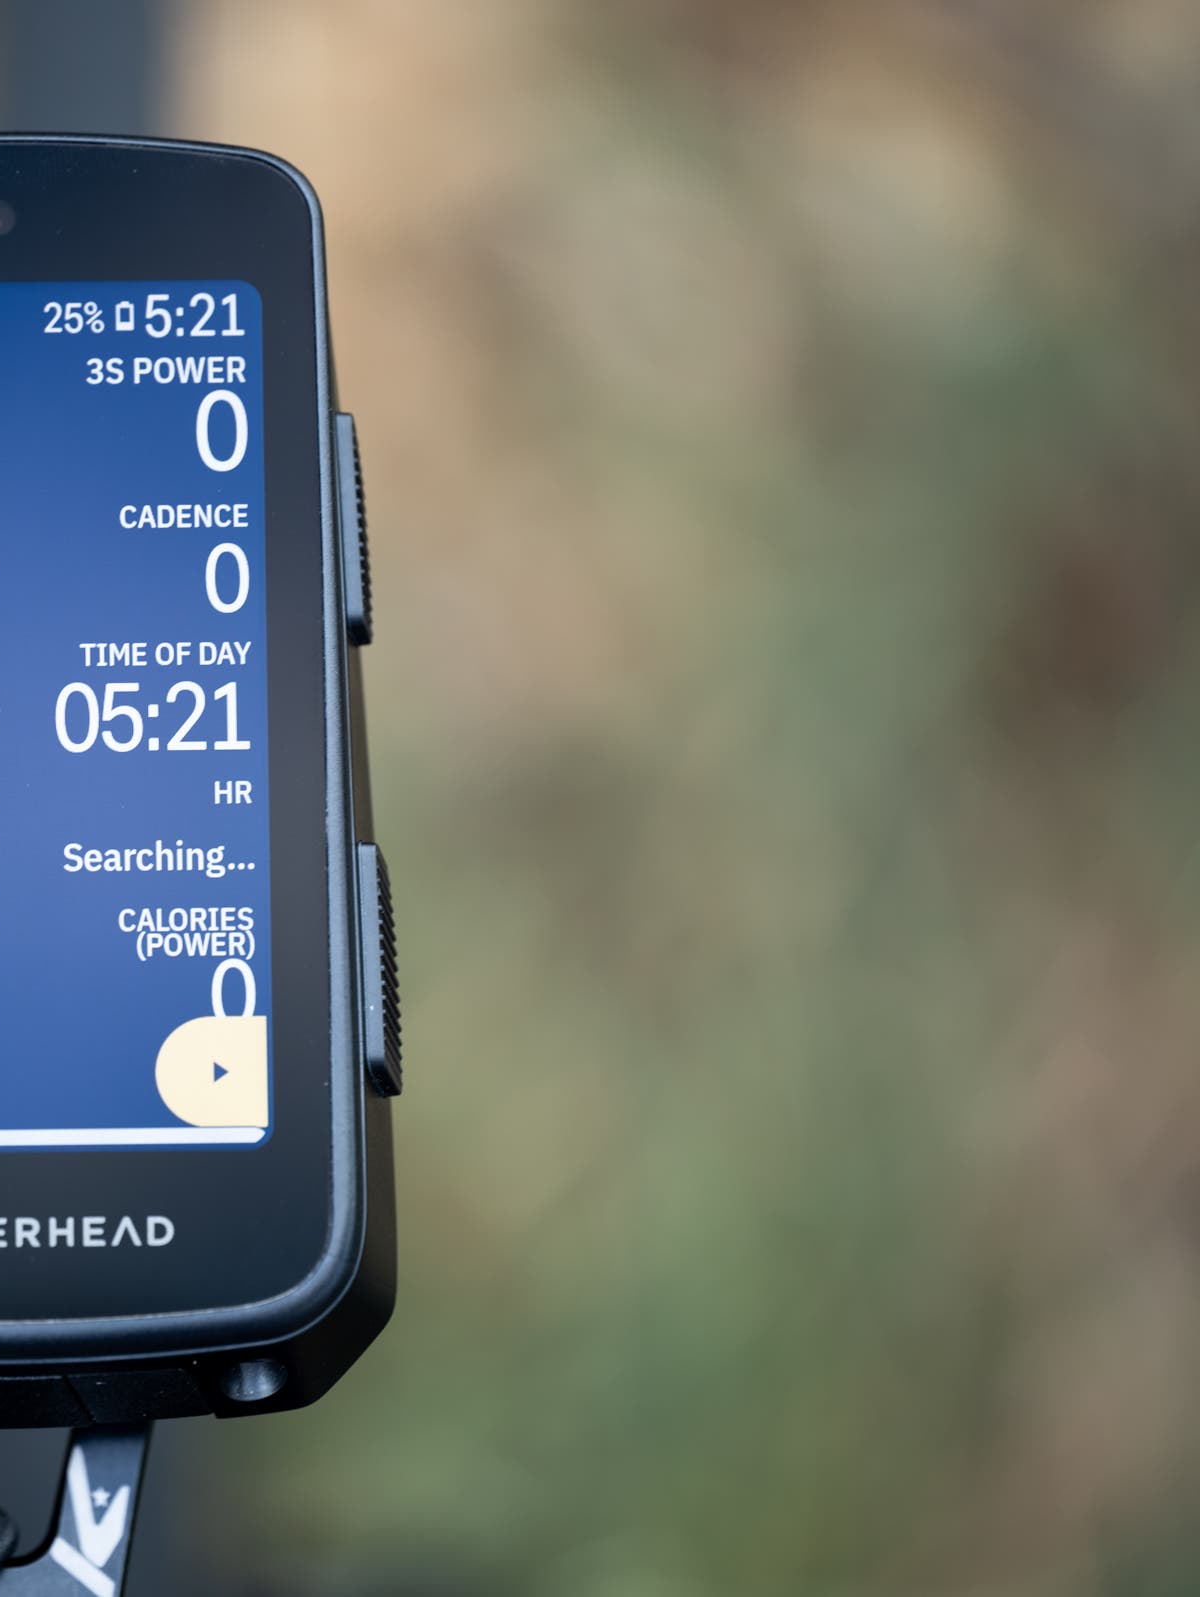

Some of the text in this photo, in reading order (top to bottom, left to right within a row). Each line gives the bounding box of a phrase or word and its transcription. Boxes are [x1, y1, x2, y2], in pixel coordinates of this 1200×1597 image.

[44, 292, 245, 338] 25% 5:21
[86, 356, 246, 385] 3S POWER
[196, 389, 248, 472] 0
[119, 503, 249, 529] CADENCE
[205, 542, 250, 614] 0
[79, 641, 252, 667] TIME OF DAY
[54, 680, 251, 754] 05:21
[214, 780, 253, 805] HR
[63, 839, 256, 879] Searching...
[118, 906, 254, 932] CALORIES
[136, 930, 256, 961] (POWER)
